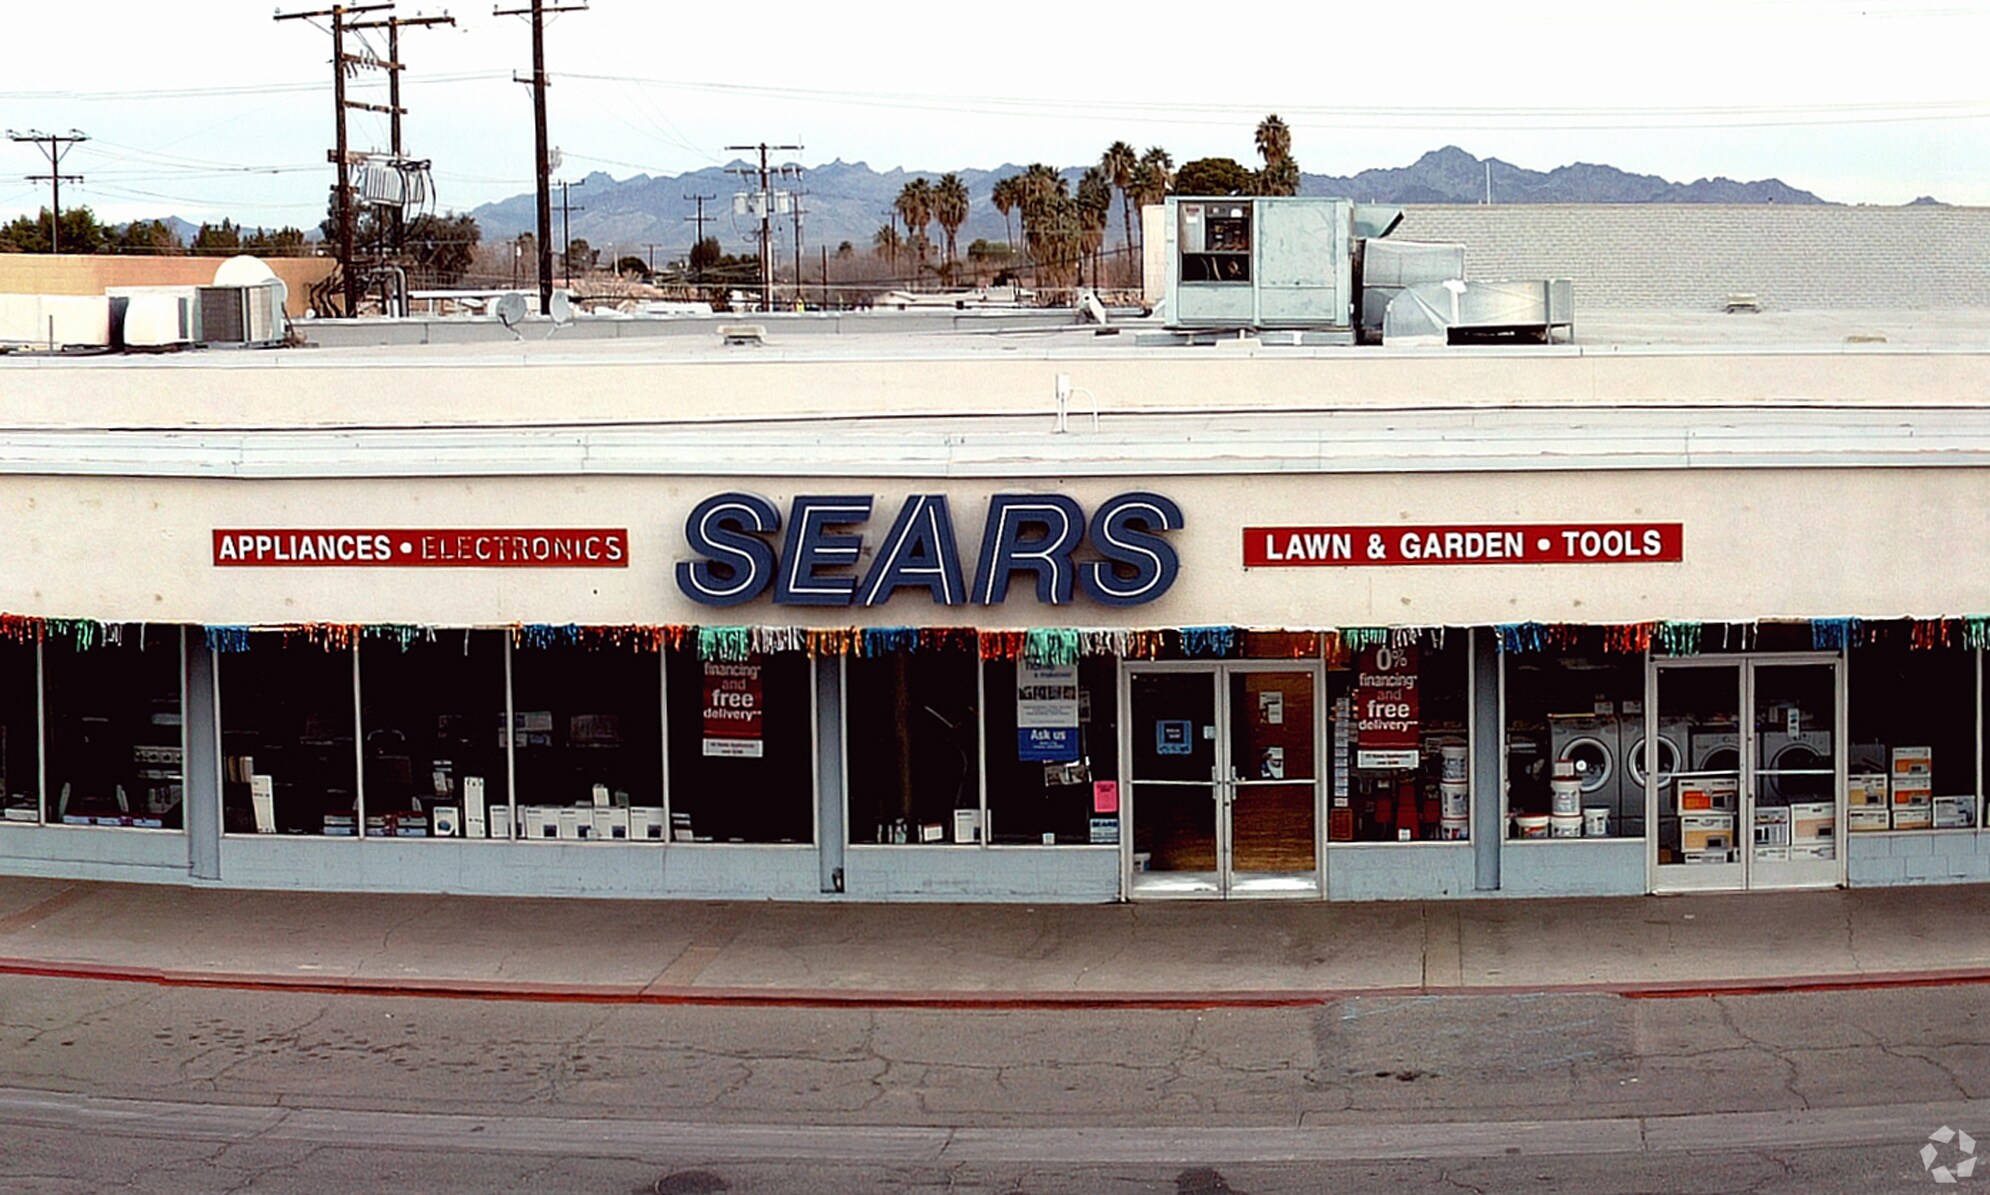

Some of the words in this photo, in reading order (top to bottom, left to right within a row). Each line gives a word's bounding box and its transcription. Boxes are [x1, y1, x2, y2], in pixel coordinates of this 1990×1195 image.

[219, 534, 392, 561] APPLIANCES
[421, 536, 623, 560] ELECTRONICS
[675, 491, 1185, 608] SEARS
[1266, 533, 1352, 560] LAWN
[1366, 533, 1386, 560] &
[1400, 531, 1525, 559] GARDEN
[1562, 530, 1662, 557] TOOLS
[1376, 648, 1408, 671] 0%
[722, 679, 746, 690] and
[712, 689, 754, 708] free
[1377, 689, 1402, 701] and
[1367, 700, 1410, 718] free
[1030, 729, 1051, 741] Ask
[1053, 731, 1066, 741] us
